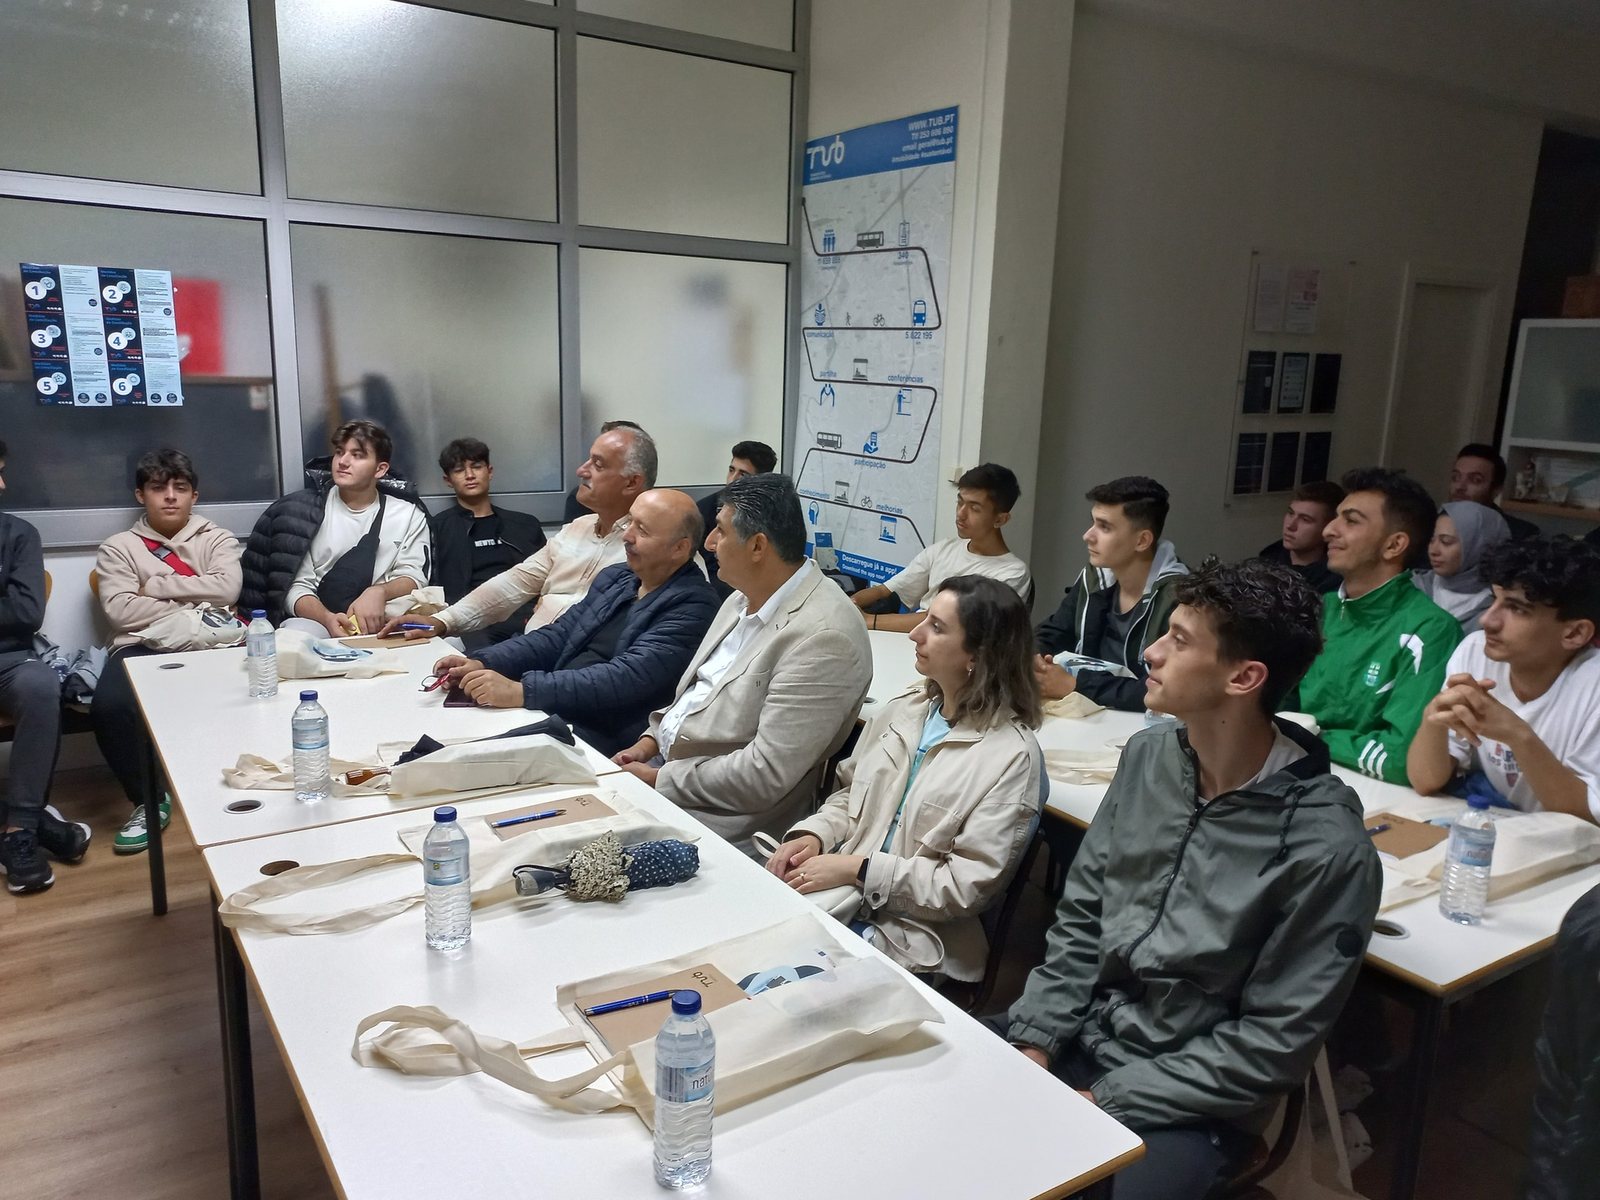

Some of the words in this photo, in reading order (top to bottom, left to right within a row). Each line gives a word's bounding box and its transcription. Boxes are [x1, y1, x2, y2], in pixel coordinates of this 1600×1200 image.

[31, 285, 39, 296] 1
[108, 289, 117, 299] 2
[37, 333, 46, 344] 3
[113, 336, 121, 346] 4
[43, 381, 51, 391] 5
[118, 382, 126, 391] 6
[854, 458, 886, 470] participação
[876, 503, 903, 515] melhorias
[842, 553, 874, 569] Descarregue
